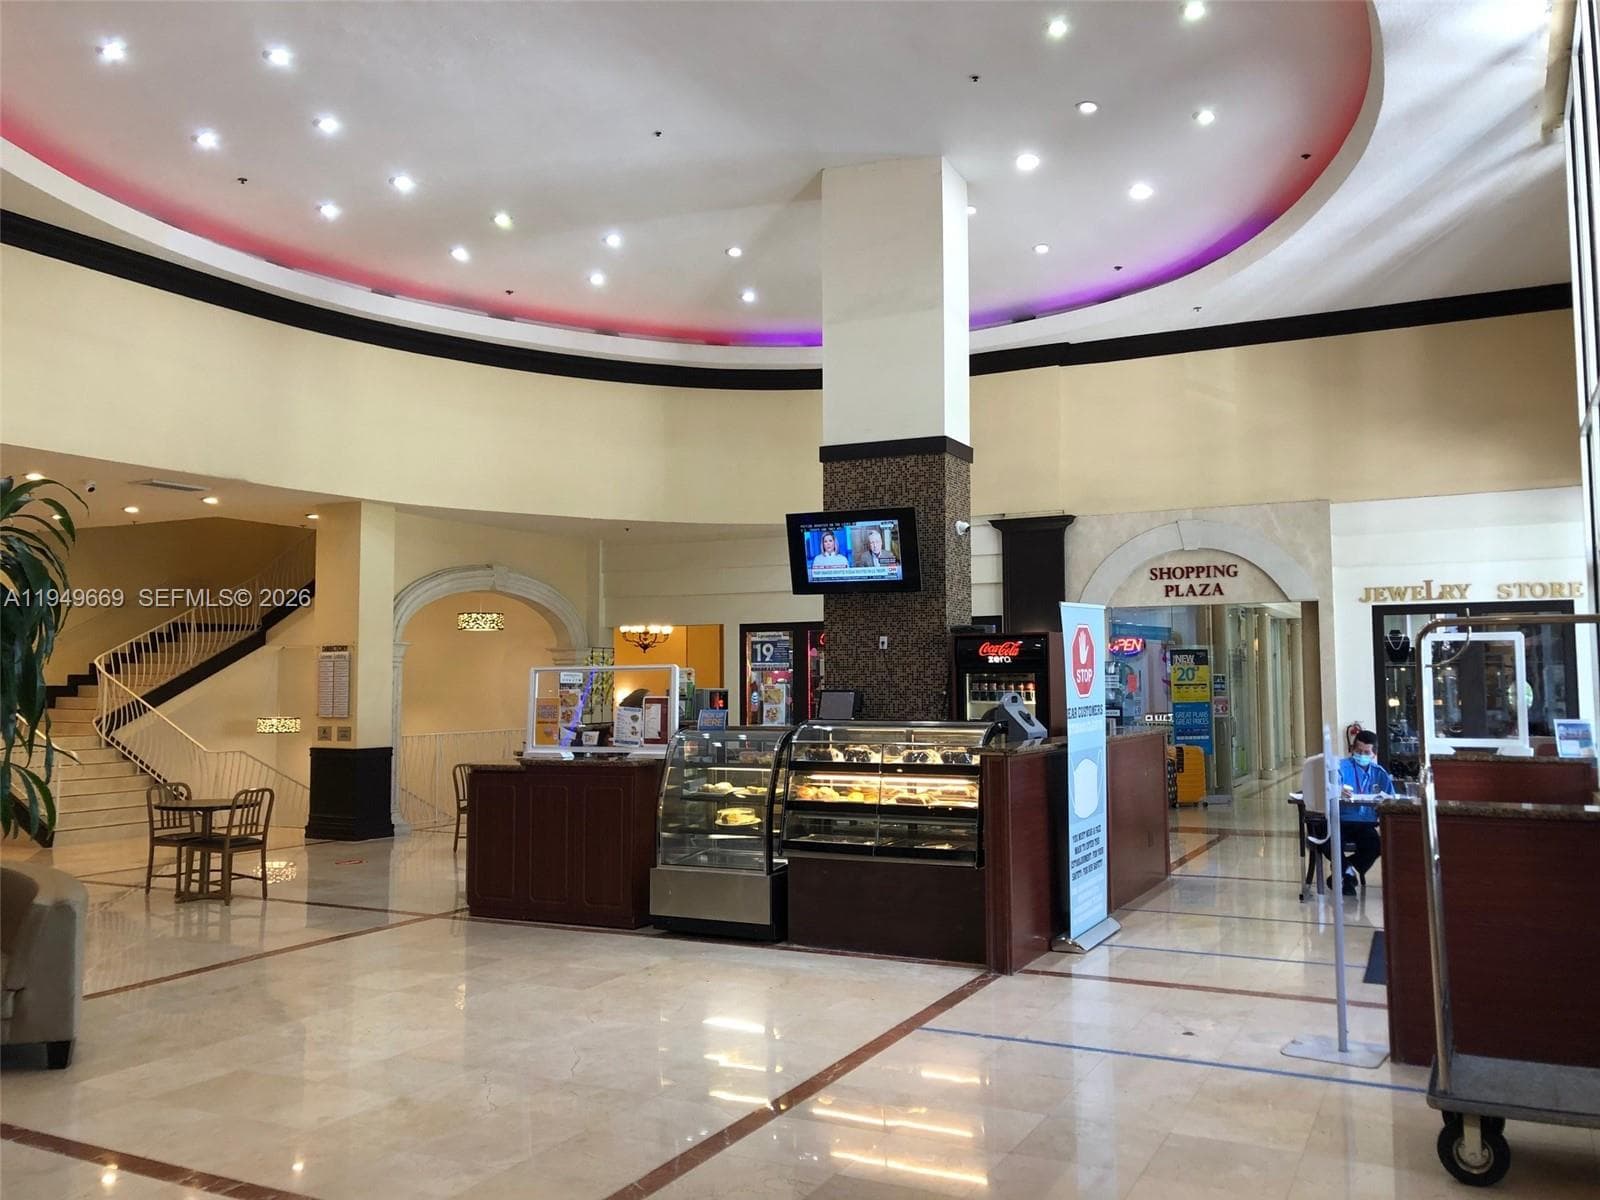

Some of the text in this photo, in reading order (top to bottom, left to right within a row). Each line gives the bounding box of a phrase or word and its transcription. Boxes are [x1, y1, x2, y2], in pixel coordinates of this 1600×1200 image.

[1150, 564, 1238, 580] SHOPPING
[1164, 583, 1225, 597] PLAZA
[1359, 579, 1585, 604] JEWELRY STORE
[979, 641, 1020, 656] Coca-Cola
[1108, 638, 1143, 653] OPEN
[987, 655, 1012, 664] zero
[1077, 668, 1092, 683] STOP
